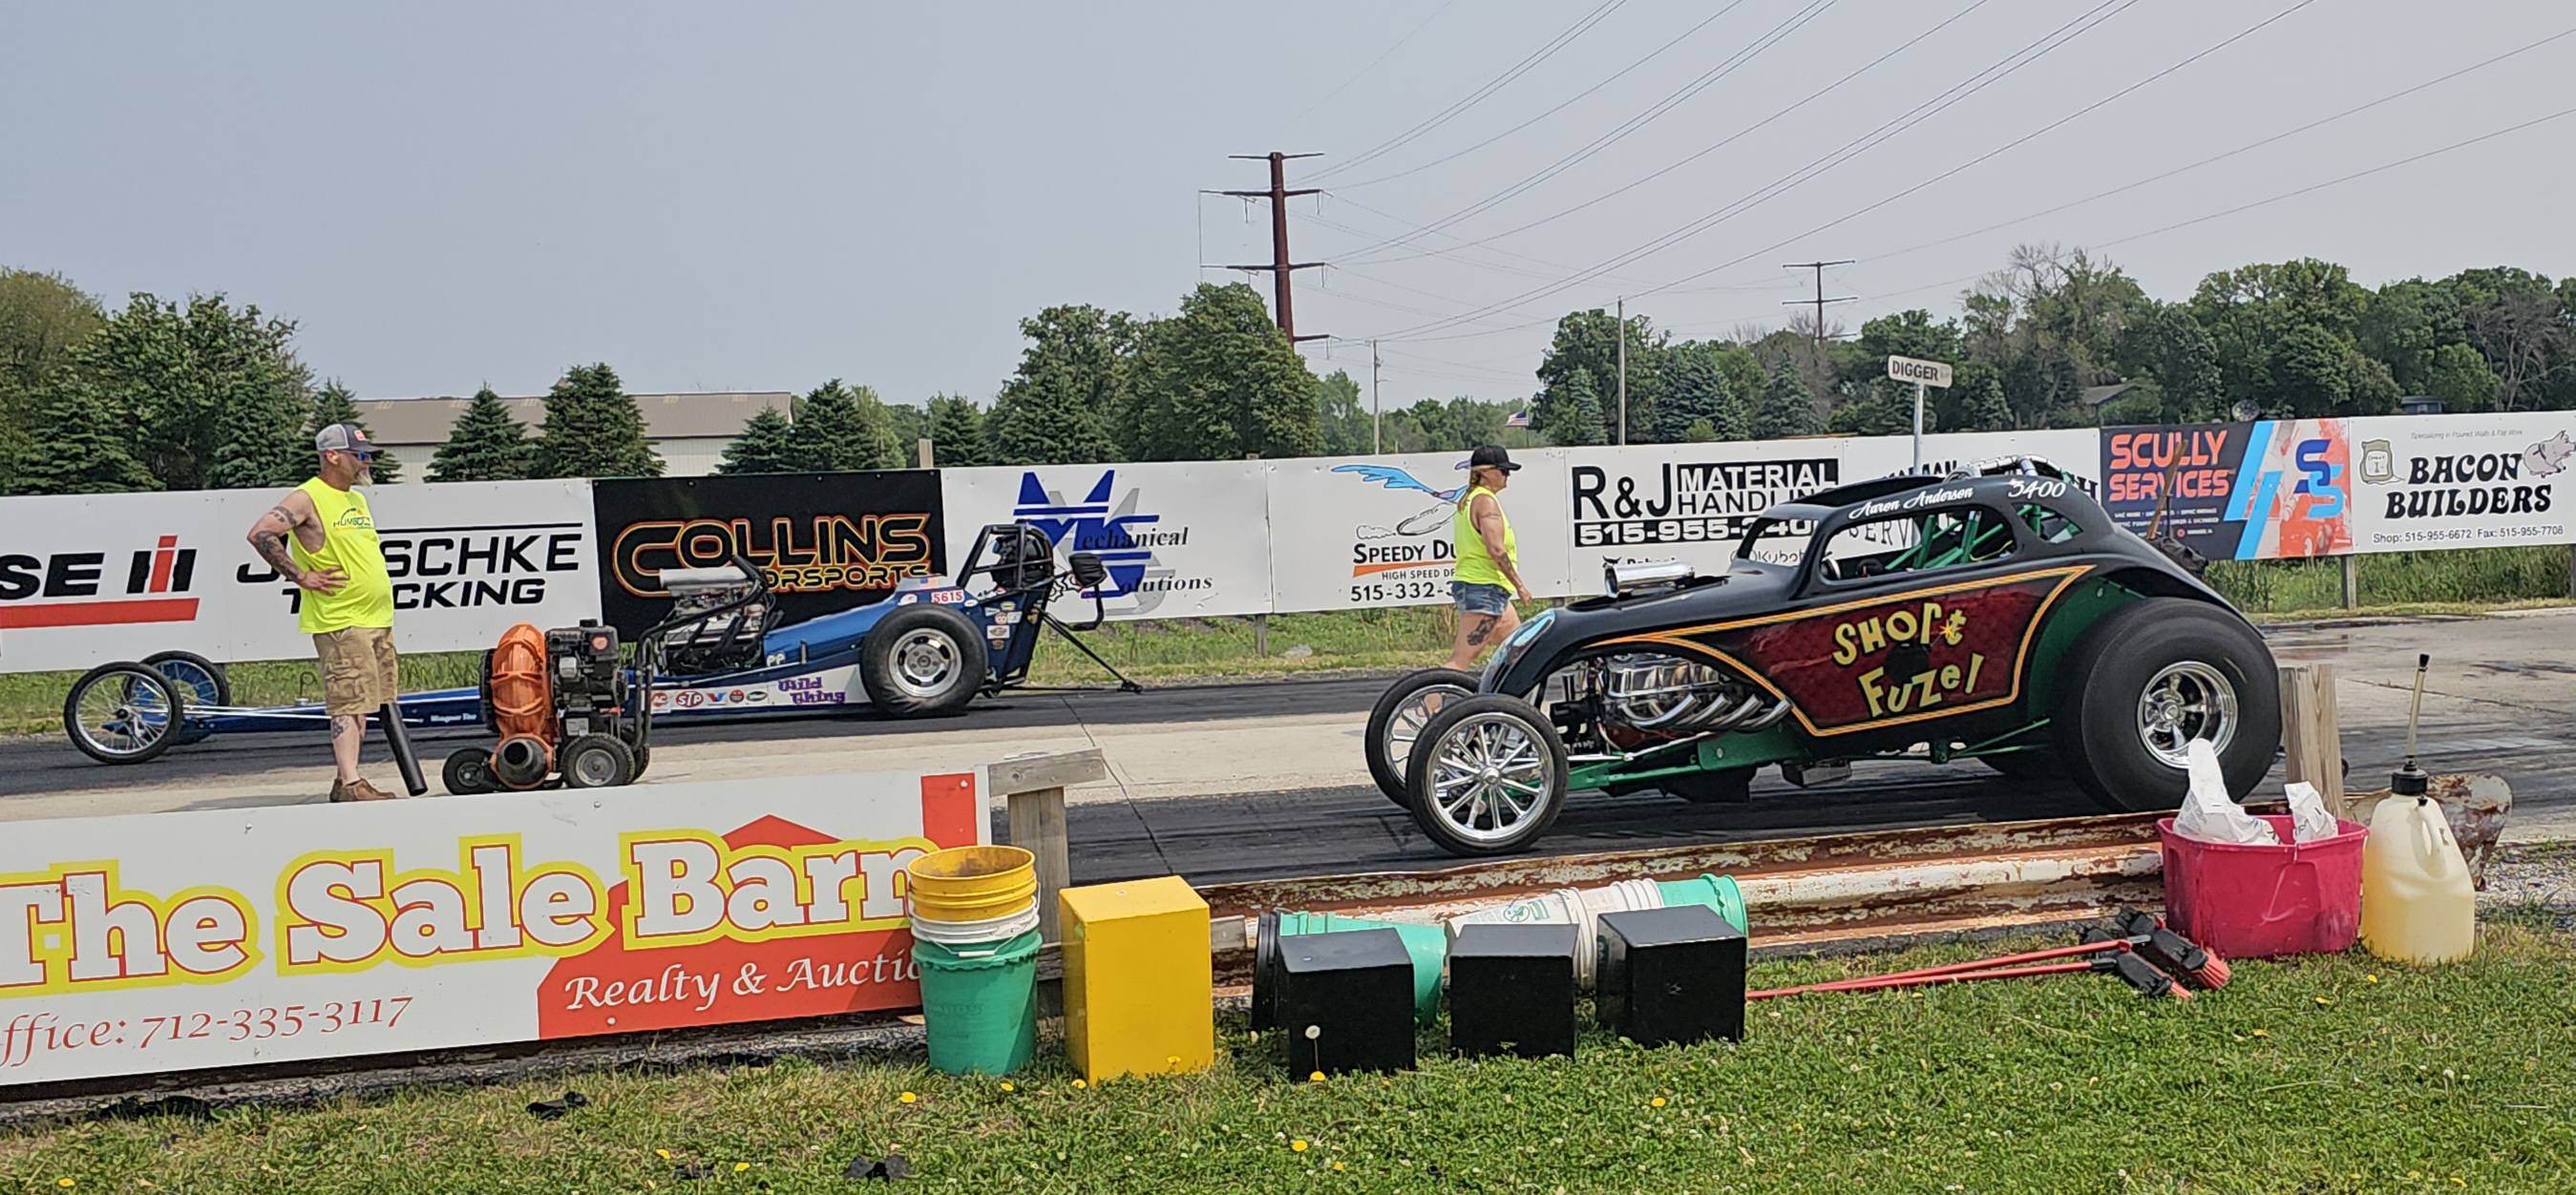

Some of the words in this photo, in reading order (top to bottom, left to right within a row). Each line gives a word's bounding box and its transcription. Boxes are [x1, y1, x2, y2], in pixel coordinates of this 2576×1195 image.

[1891, 360, 1938, 382] DIGGER
[2109, 430, 2228, 470] SCULLY
[2108, 469, 2230, 502] SERVICES
[2408, 453, 2523, 485] BACON
[1572, 463, 1671, 520] R&J
[1679, 463, 1837, 493] MATERIAL
[1848, 501, 1900, 519] Aaron
[1903, 486, 1974, 509] Anderson
[2384, 485, 2552, 519] BUILDERS
[1579, 516, 1818, 545] 515-955-340
[2373, 533, 2403, 544] Shop:
[2405, 529, 2472, 543] 515-955-6672
[2478, 528, 2498, 538] Fax:
[2500, 525, 2565, 537] 515-955-7708
[612, 512, 931, 596] COLLINS
[1353, 542, 1426, 564] SPEEDY
[1382, 570, 1406, 580] HIGH
[1410, 568, 1440, 579] SPEED
[282, 578, 546, 615] TCKING
[933, 591, 963, 603] 5615
[677, 691, 702, 706] STP
[0, 870, 249, 989] The
[285, 843, 600, 966] Sale
[630, 839, 914, 938] Barn
[565, 963, 721, 1011] Realty
[731, 962, 767, 996] &
[776, 948, 920, 993] Auctio
[0, 1012, 126, 1067] ffice:
[139, 996, 413, 1049] 712-335-3117
